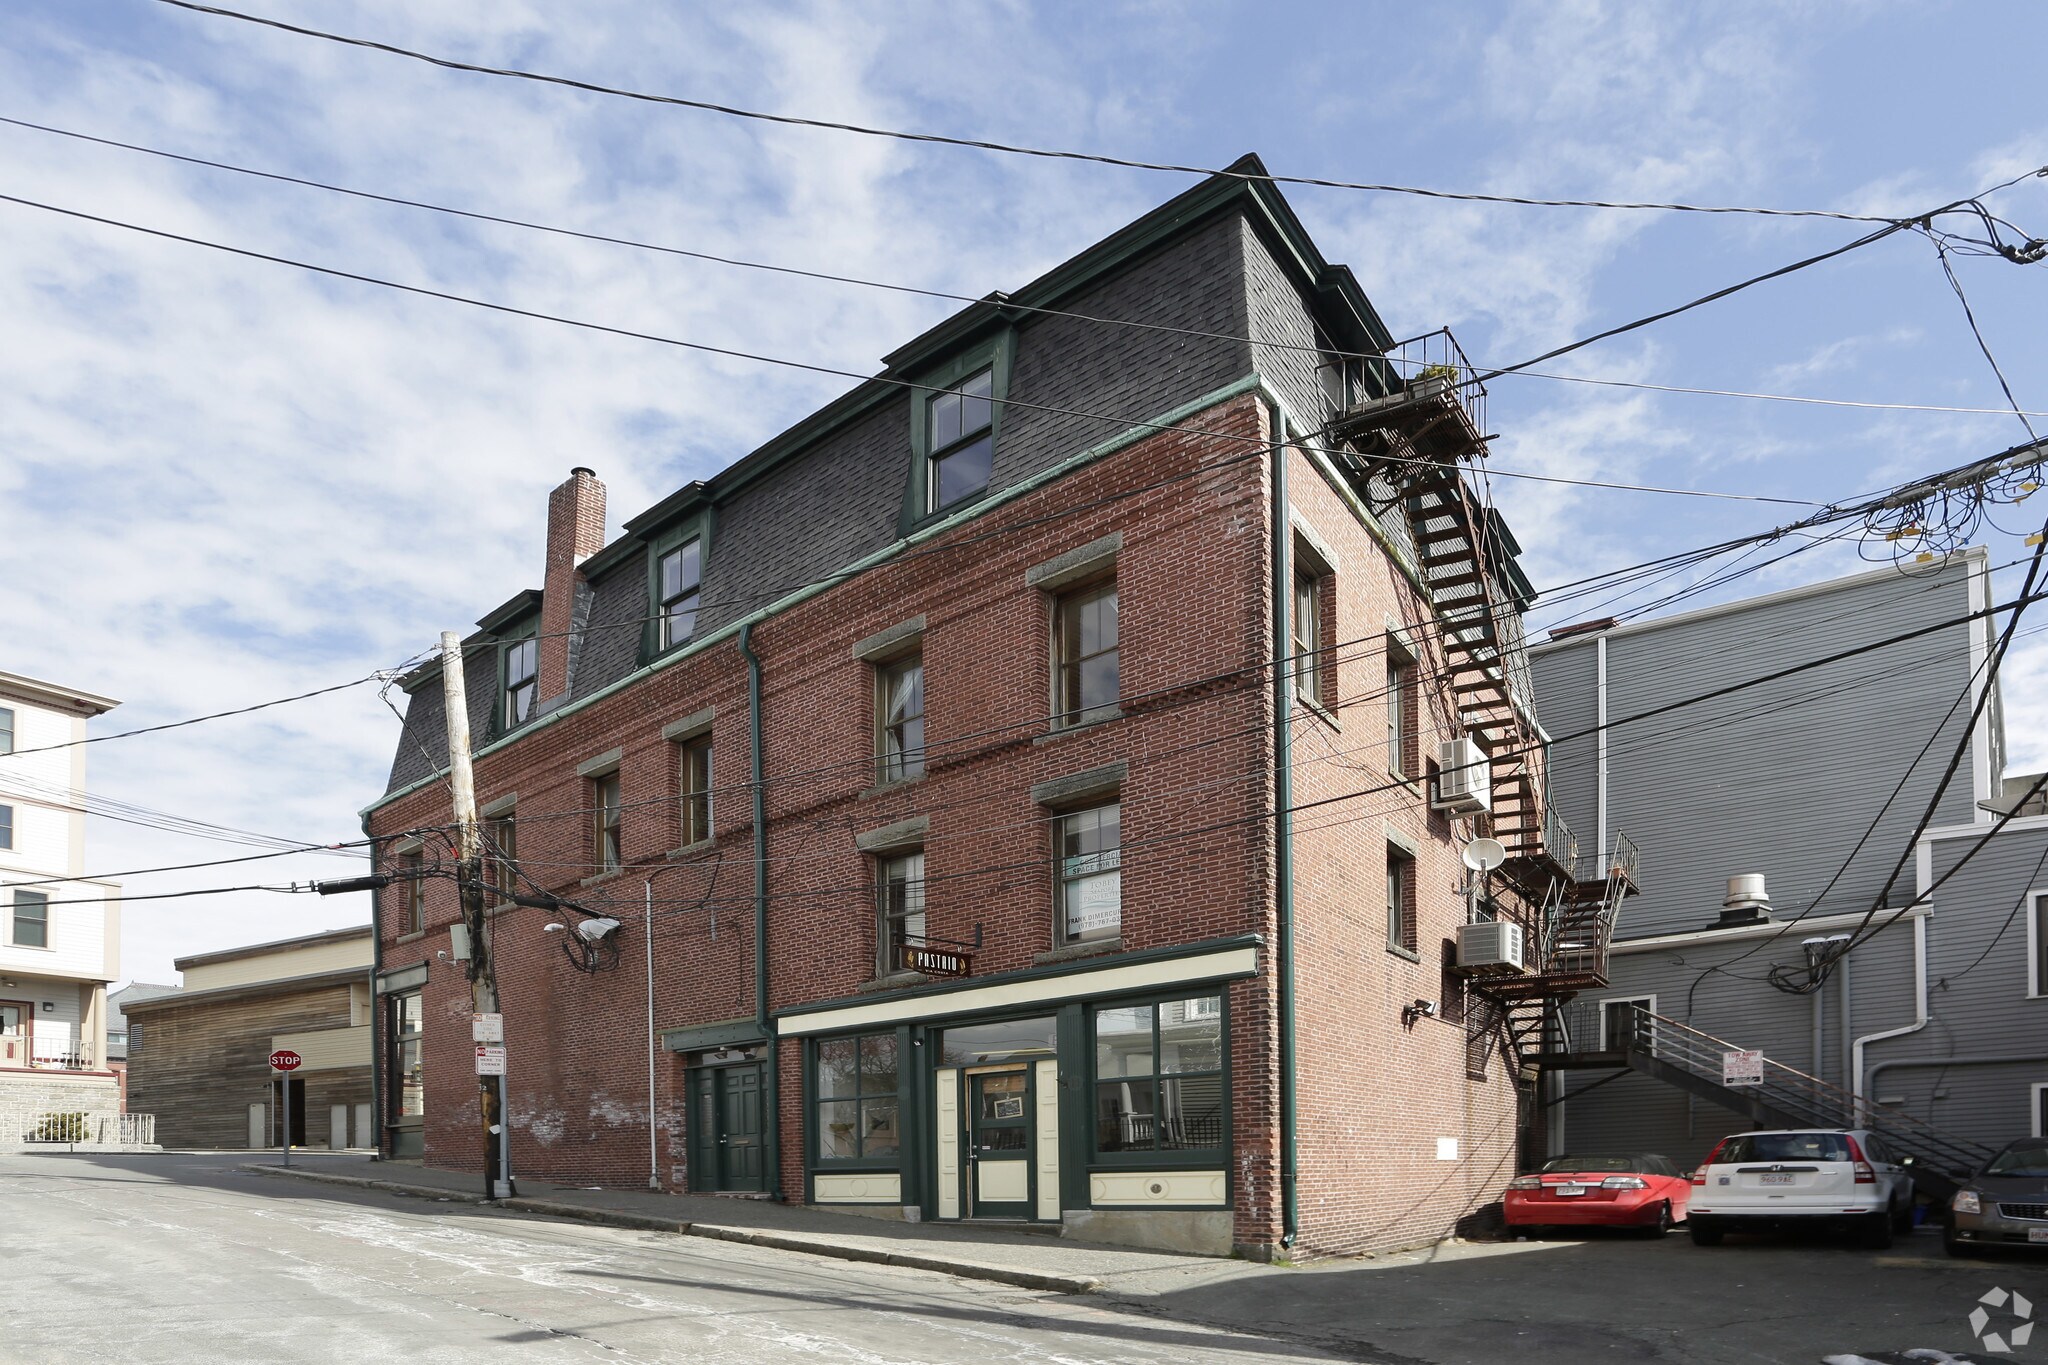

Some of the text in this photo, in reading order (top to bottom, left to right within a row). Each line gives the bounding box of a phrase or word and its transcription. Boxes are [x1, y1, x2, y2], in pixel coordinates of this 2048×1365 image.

[1072, 864, 1095, 875] SPACE
[1090, 878, 1115, 890] TOBEY
[271, 1056, 300, 1065] STOP
